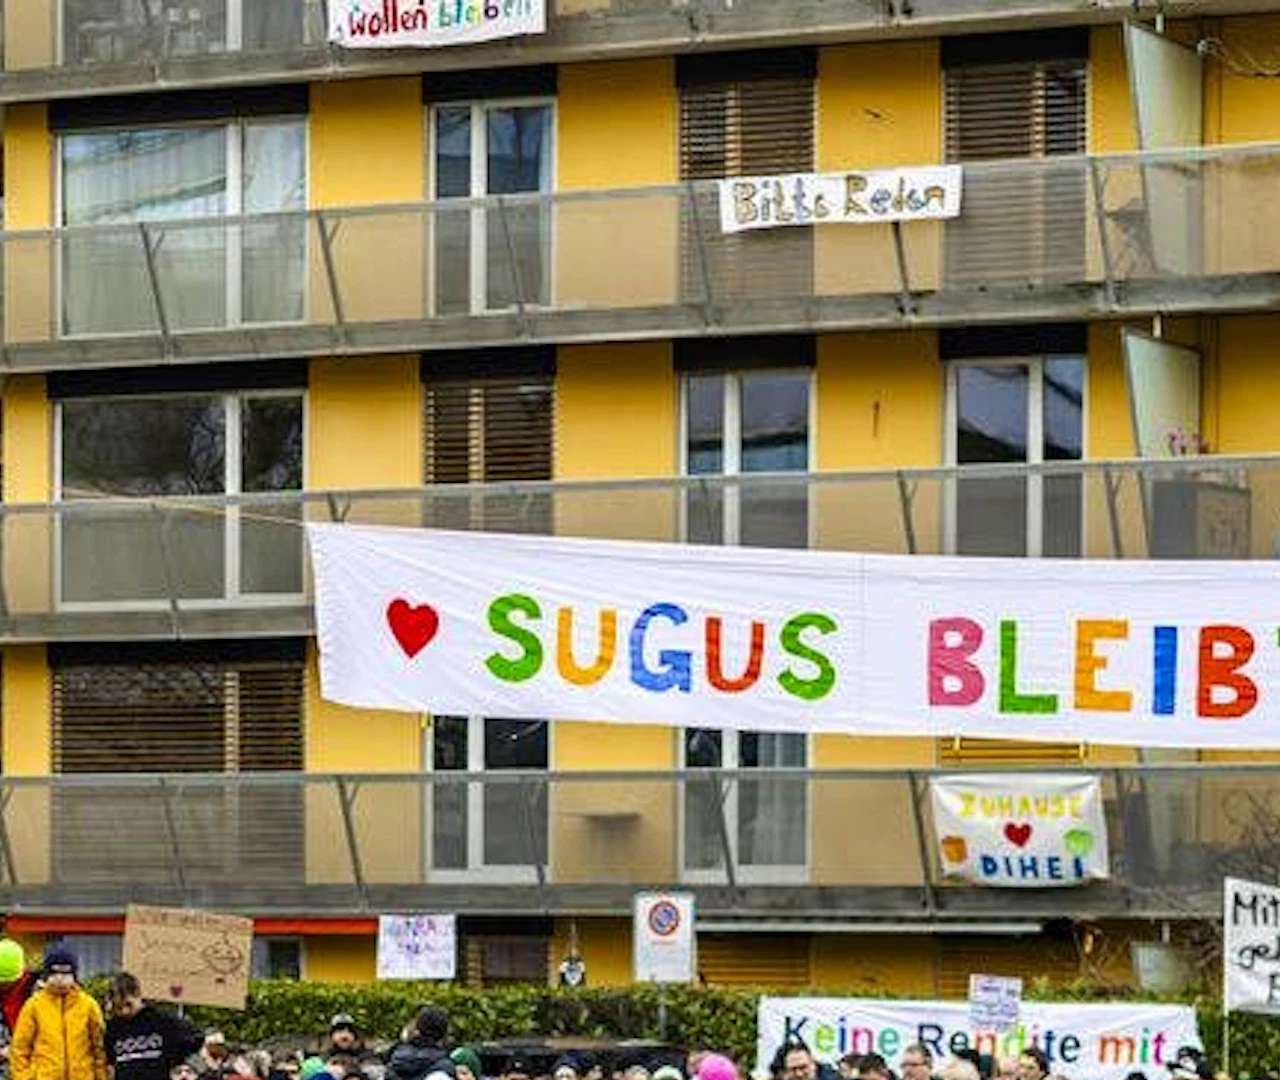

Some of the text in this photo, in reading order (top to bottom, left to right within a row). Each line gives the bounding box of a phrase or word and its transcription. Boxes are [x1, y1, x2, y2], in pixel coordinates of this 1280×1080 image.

[483, 593, 839, 700] SUGUS
[1233, 891, 1280, 926] Mit
[784, 1016, 1169, 1066] Keine Rendite mit
